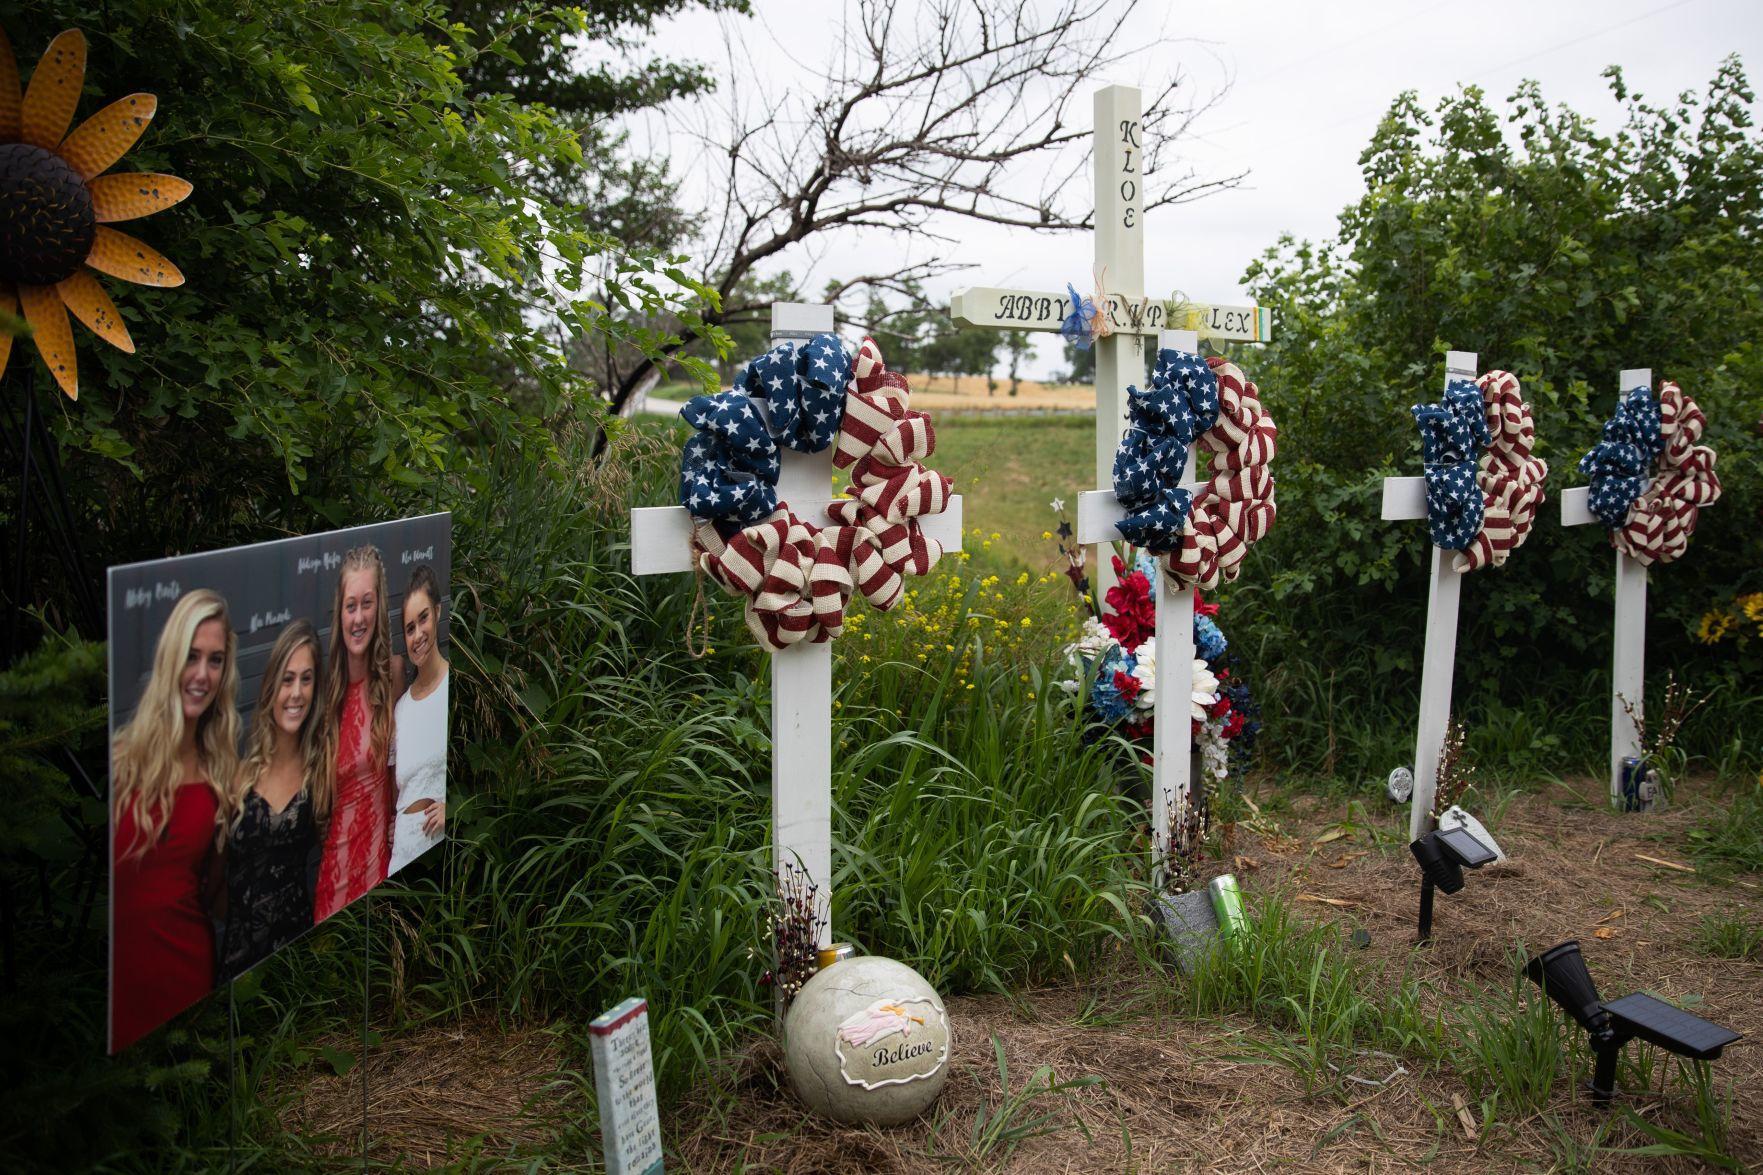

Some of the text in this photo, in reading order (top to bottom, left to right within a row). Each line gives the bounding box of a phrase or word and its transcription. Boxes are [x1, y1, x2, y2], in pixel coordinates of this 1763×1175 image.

[1120, 120, 1140, 229] KLOE
[994, 295, 1070, 323] ABBY
[872, 1040, 933, 1068] Believe
